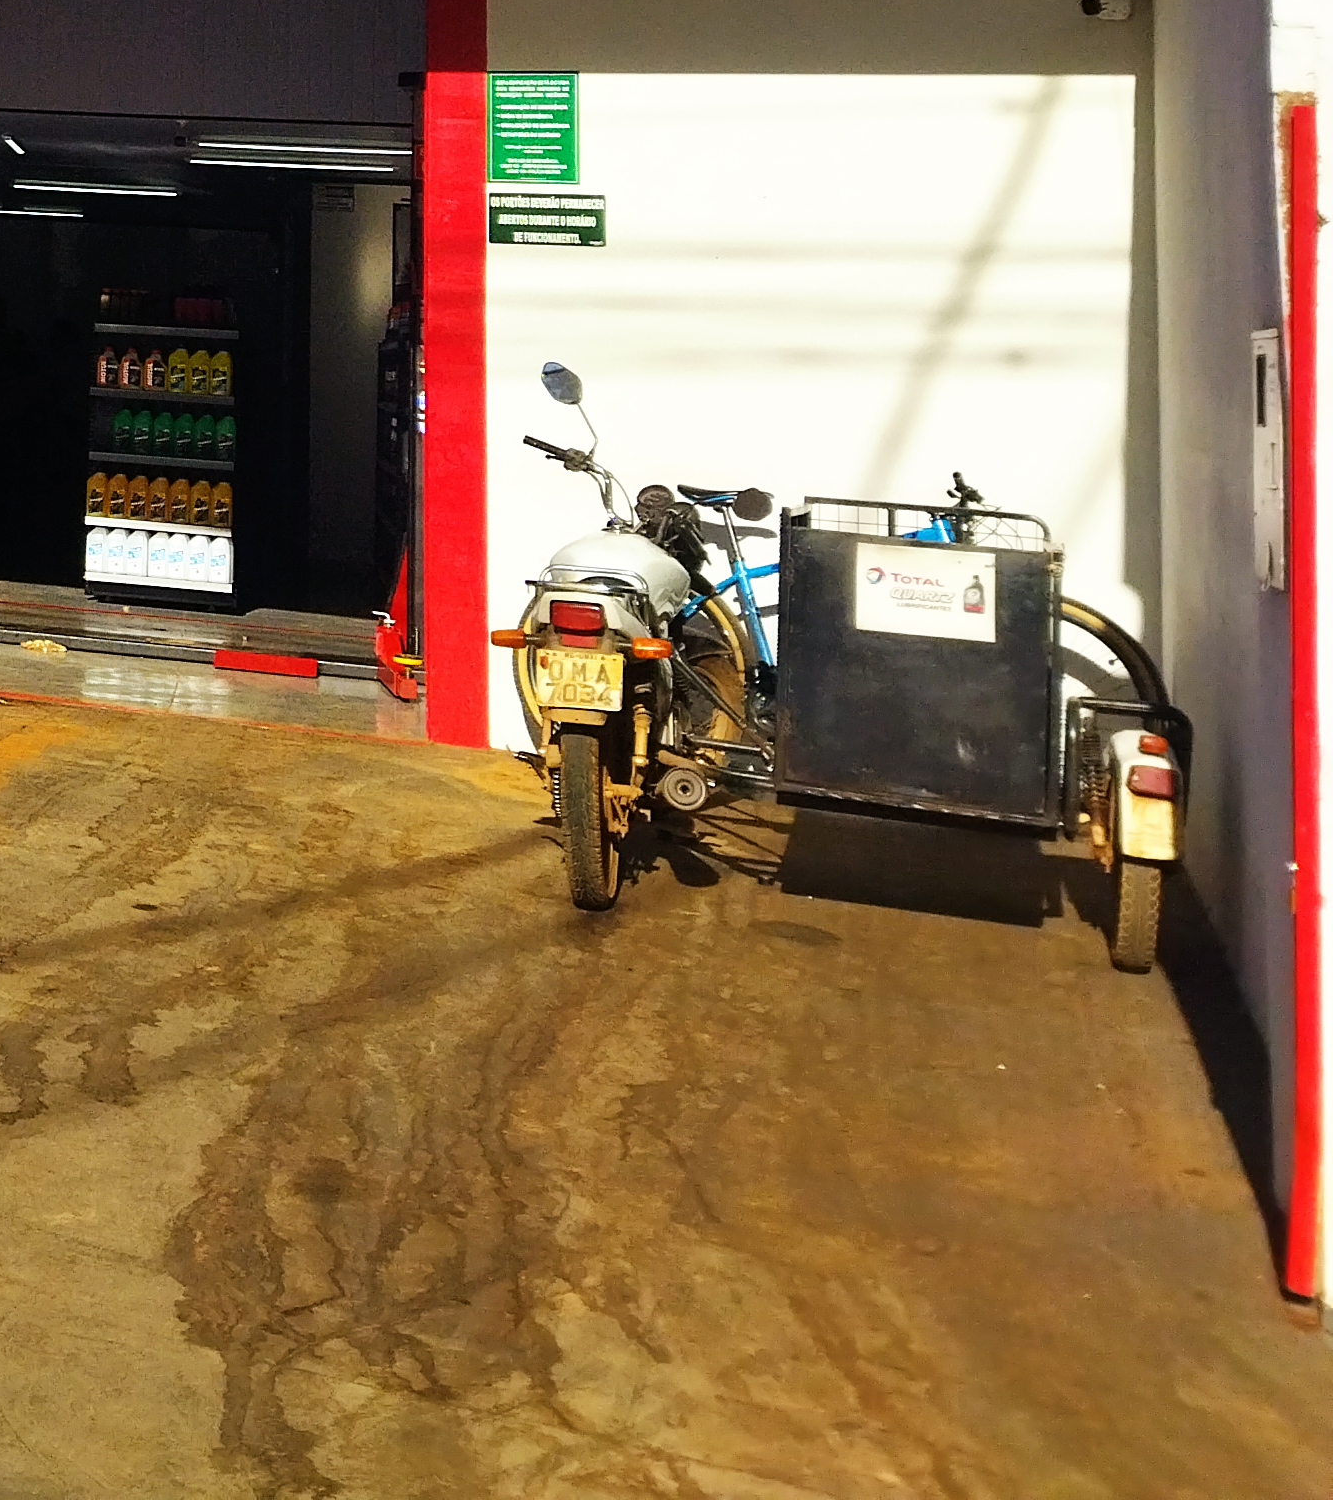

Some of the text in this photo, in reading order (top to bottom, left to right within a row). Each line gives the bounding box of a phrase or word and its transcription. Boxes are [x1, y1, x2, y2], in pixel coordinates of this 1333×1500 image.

[501, 195, 530, 208] PORTÕES
[560, 198, 605, 210] PERMANECER
[498, 214, 529, 225] ABERTOS
[529, 215, 560, 226] DURANTE
[566, 213, 597, 227] HORÁRIO
[890, 572, 945, 587] TOTAL
[889, 586, 956, 604] QUARTZ
